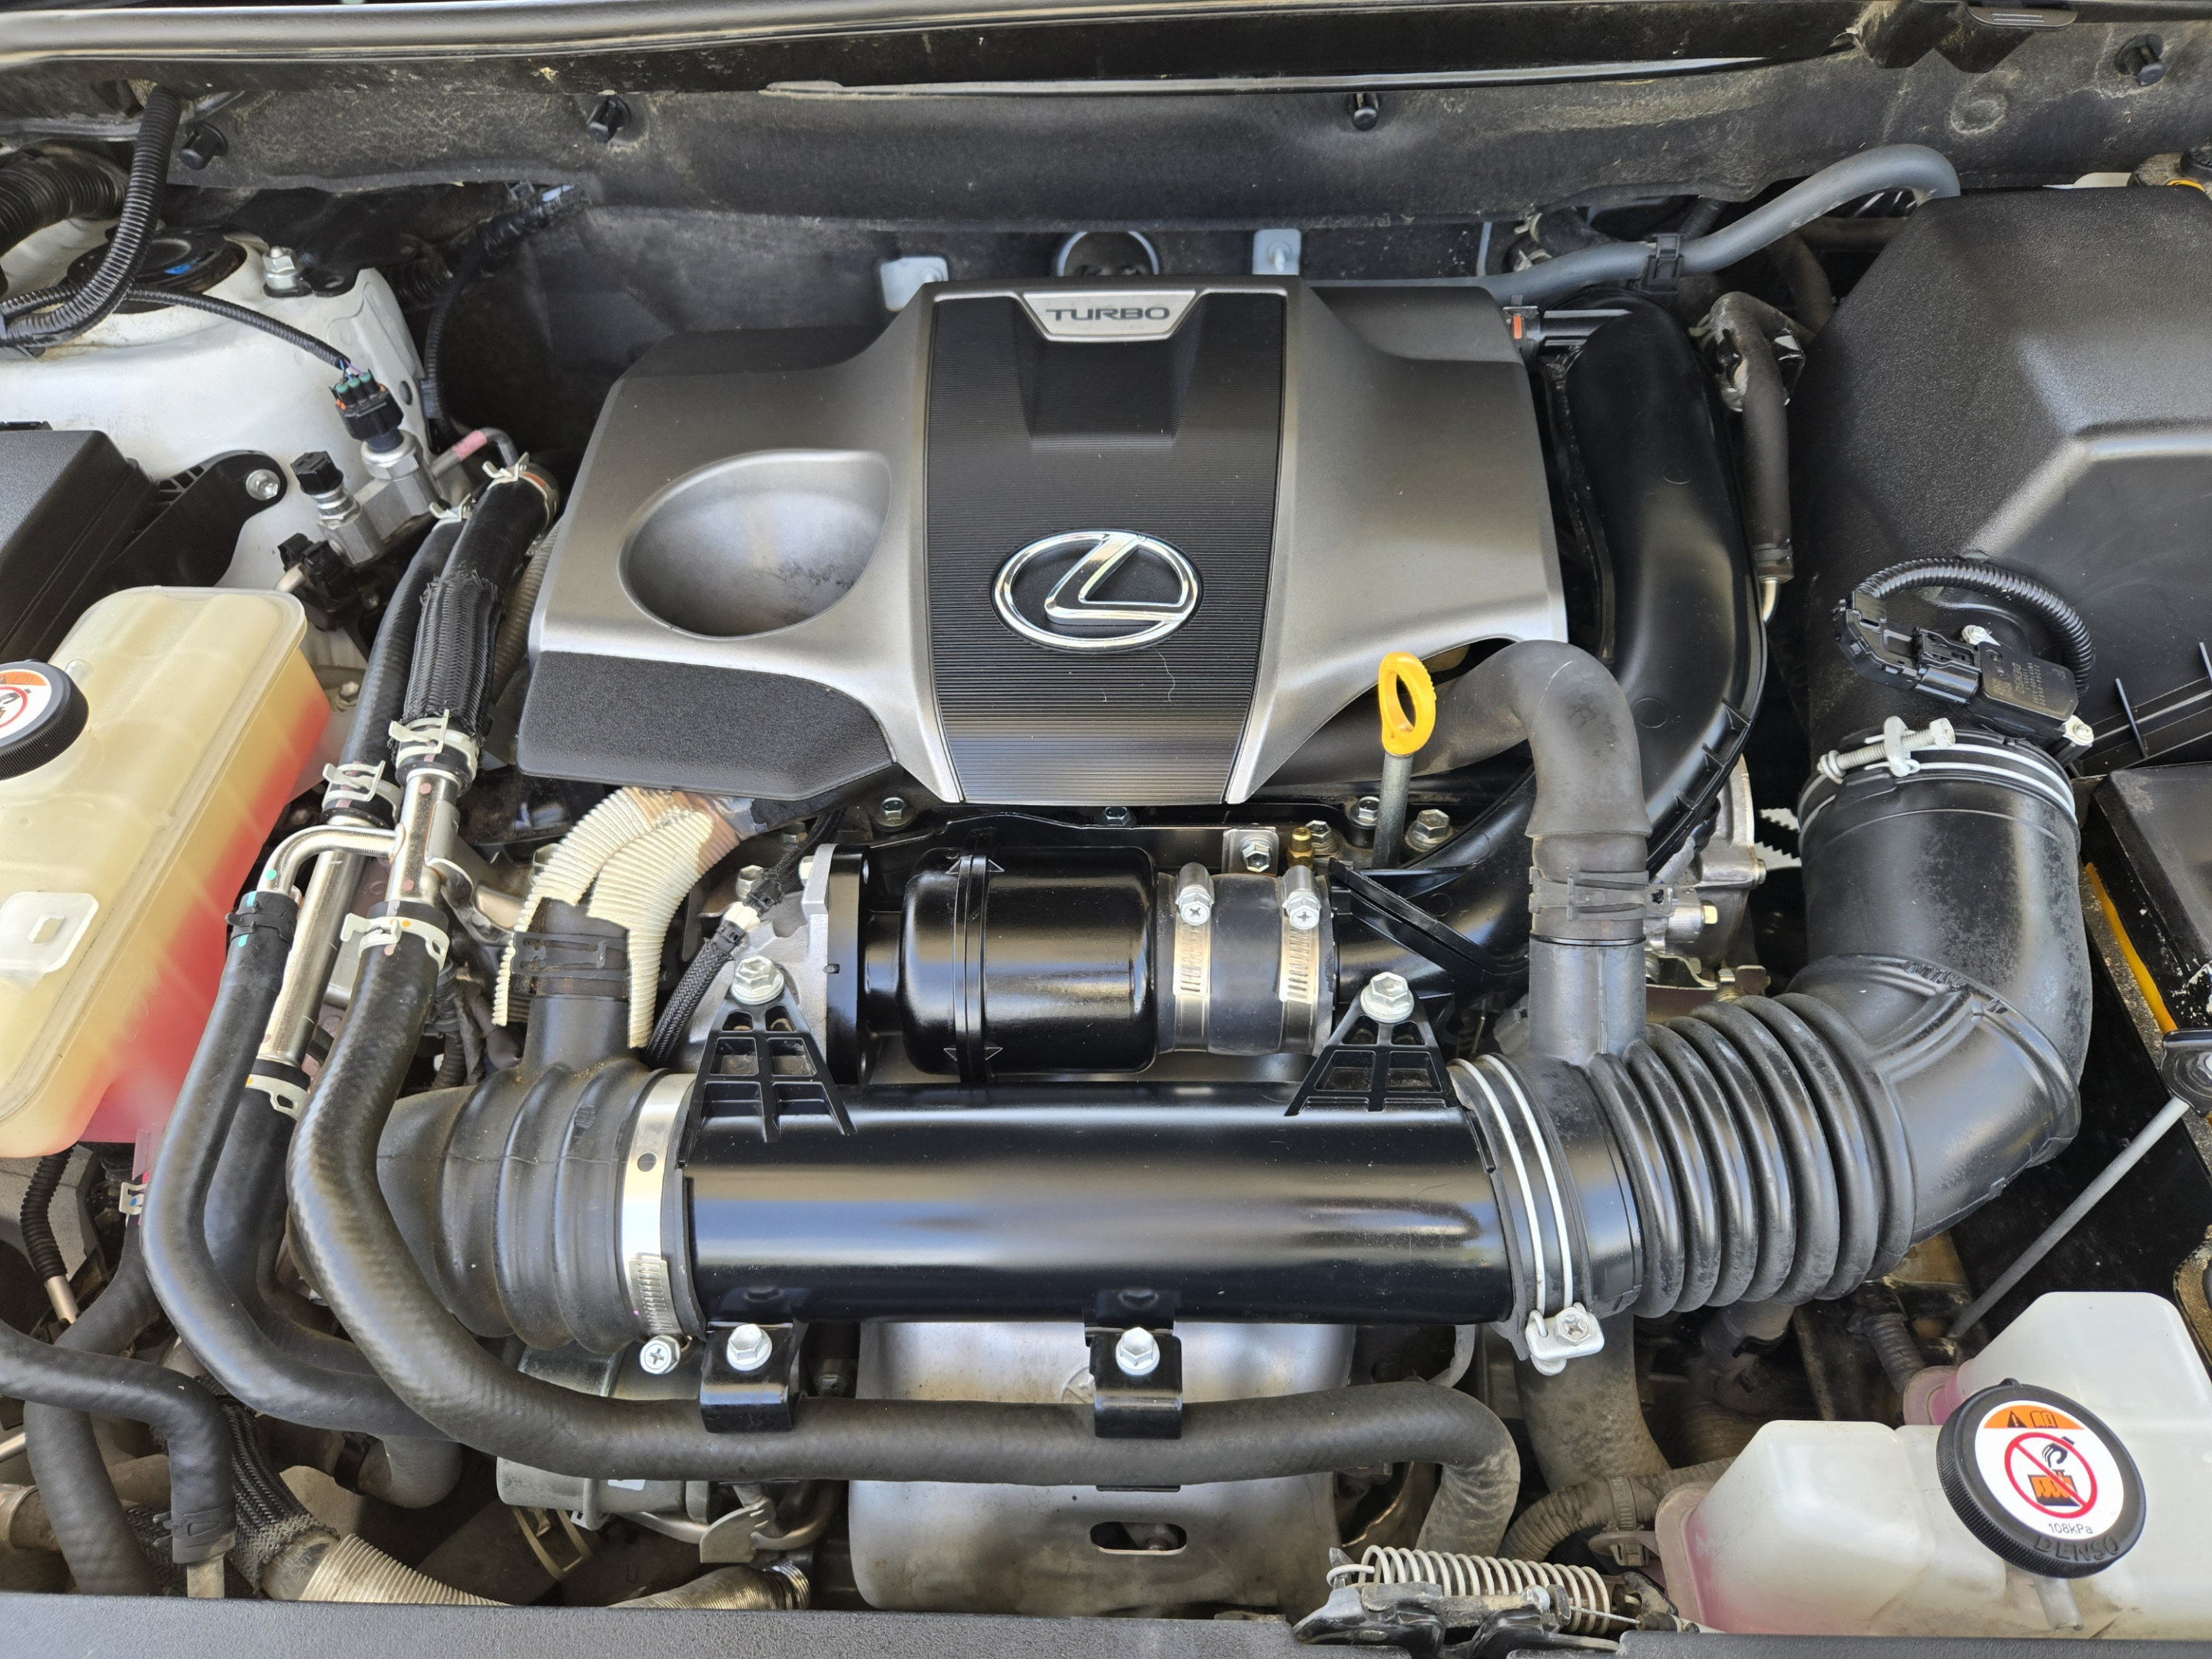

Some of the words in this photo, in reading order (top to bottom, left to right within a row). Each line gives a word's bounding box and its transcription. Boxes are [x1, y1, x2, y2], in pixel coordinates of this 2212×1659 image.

[1045, 306, 1171, 322] TURBO
[2012, 661, 2025, 694] DENSO
[2048, 1522, 2094, 1535] 108kPa
[2033, 1535, 2119, 1561] DENSO
